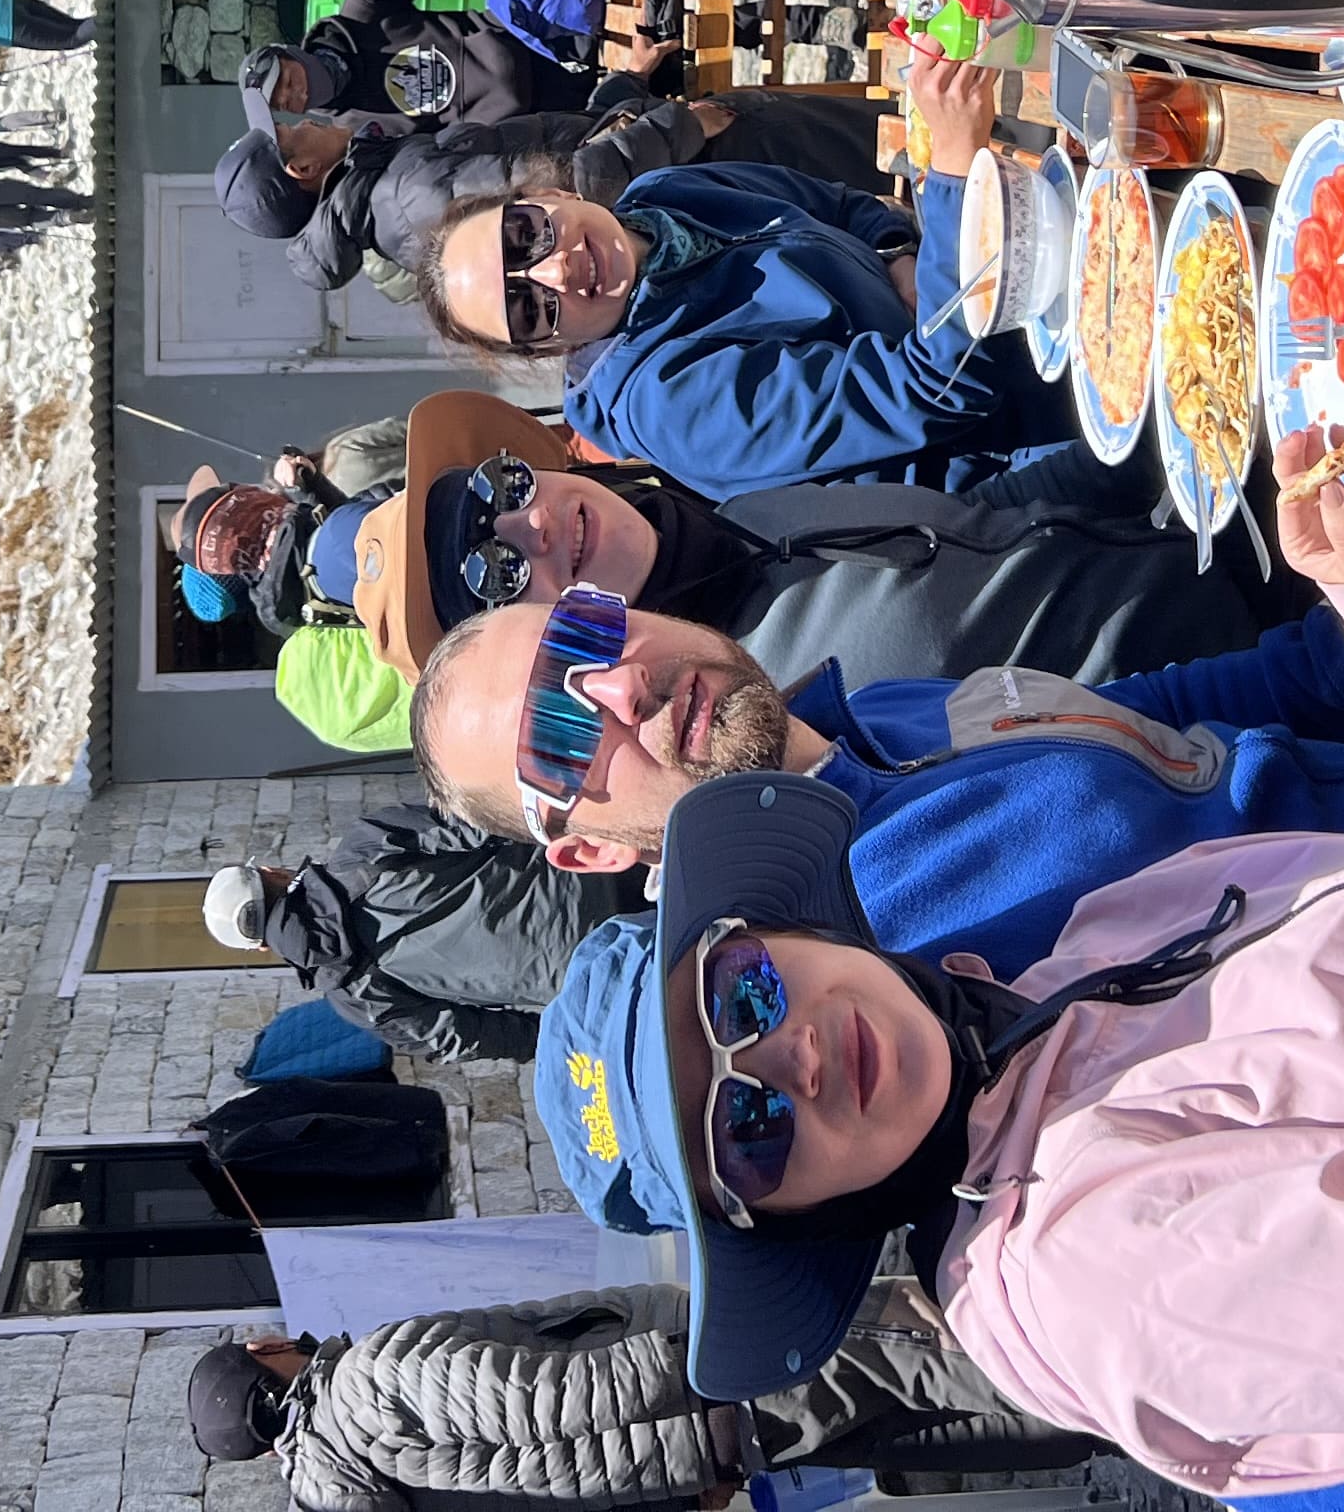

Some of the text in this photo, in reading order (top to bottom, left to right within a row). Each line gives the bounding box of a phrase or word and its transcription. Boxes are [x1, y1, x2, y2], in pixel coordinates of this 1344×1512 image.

[419, 50, 433, 113] AMA DABLAM
[237, 248, 255, 309] TOILET
[579, 1104, 607, 1161] Jack
[591, 1059, 621, 1164] Wolfskin
